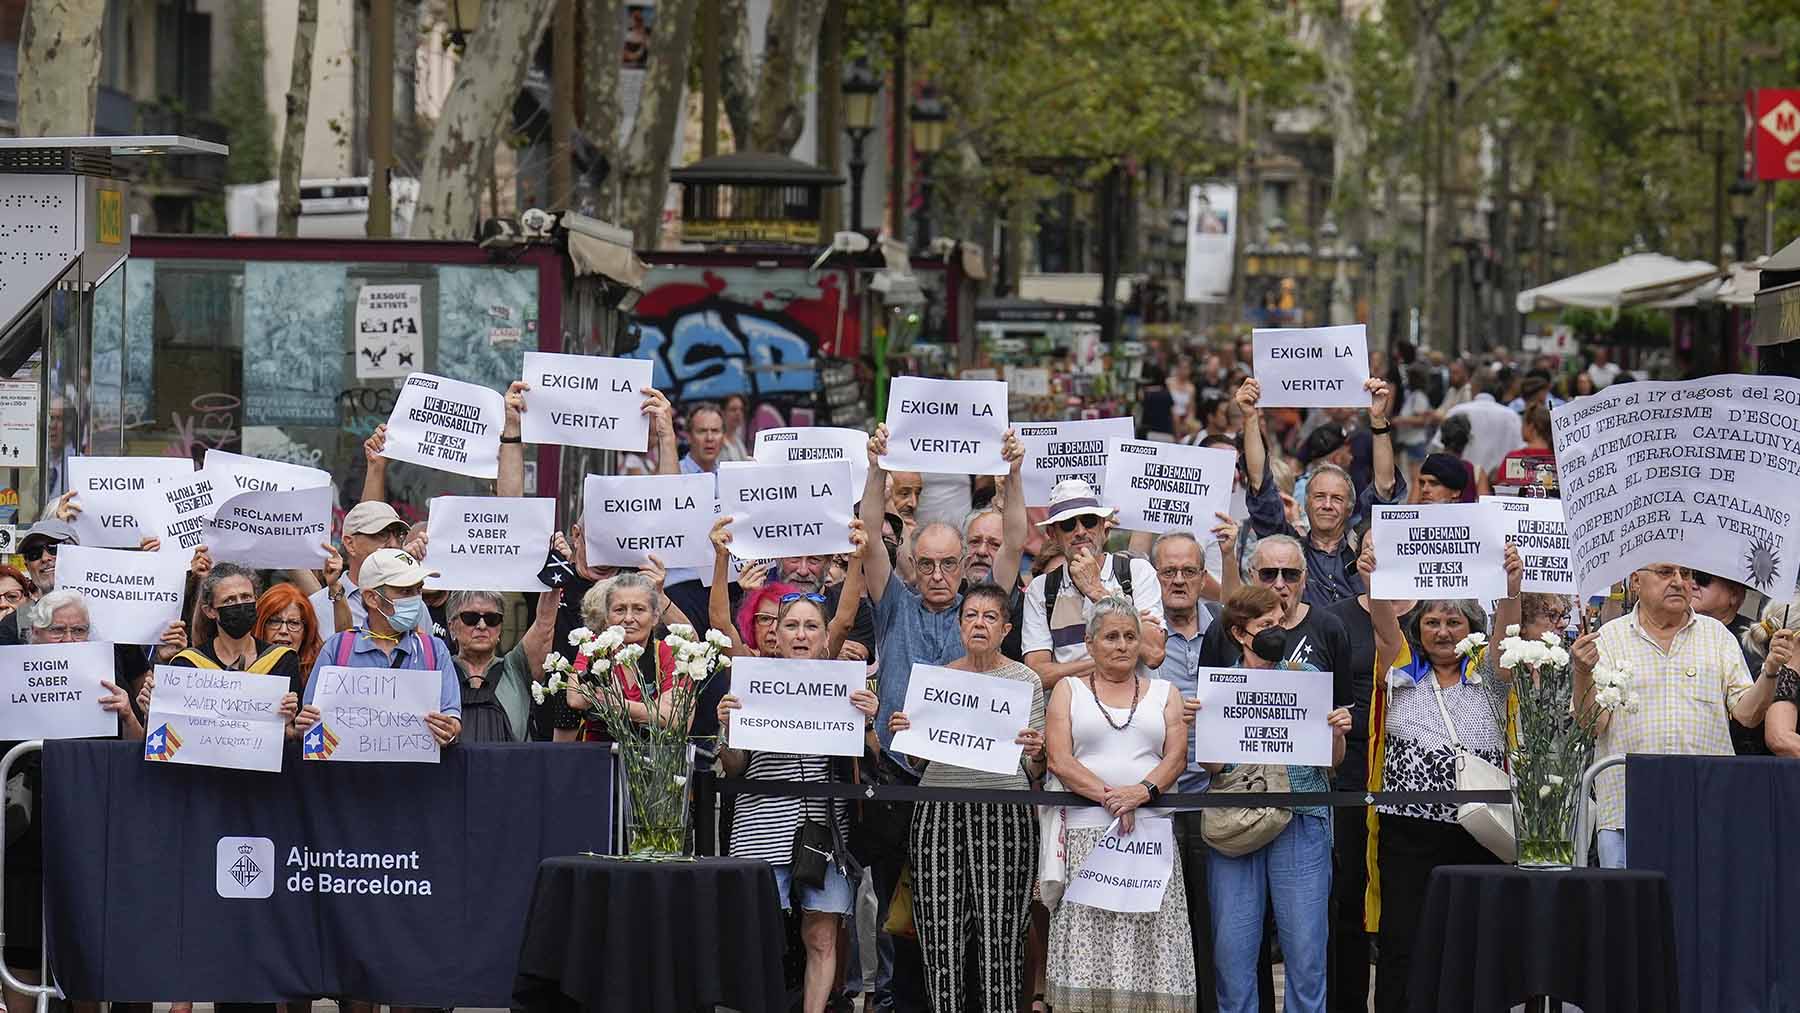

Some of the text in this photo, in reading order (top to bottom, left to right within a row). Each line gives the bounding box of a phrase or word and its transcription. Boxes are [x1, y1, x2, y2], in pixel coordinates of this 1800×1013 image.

[1777, 112, 1794, 130] M
[1271, 346, 1352, 359] EXIGIM LA
[542, 374, 632, 392] EXIGIM LA
[1282, 379, 1344, 391] VERITAT
[426, 397, 480, 418] WE DEMAND
[902, 400, 993, 416] EXIGIM LA
[1555, 417, 1570, 431] Va
[1574, 398, 1620, 426] passar
[1625, 393, 1640, 405] el
[1648, 391, 1666, 402] 17
[1672, 387, 1733, 402] d'agost
[1743, 388, 1768, 400] del
[409, 408, 487, 435] RESPONSABILITY
[551, 412, 619, 430] VERITAT
[1596, 407, 1712, 432] TERRORISME
[426, 432, 465, 448] WE ASK
[910, 438, 980, 454] VERITAT
[1049, 441, 1102, 454] WE DEMAND
[418, 443, 467, 463] THE TRUTH
[790, 448, 842, 460] WE DEMAND
[1131, 446, 1156, 455] D'AGOST
[1561, 426, 1800, 478] PER ATEMORIR CATALUNYA
[1146, 464, 1200, 480] WE DEMAND
[1588, 462, 1616, 484] SER
[1627, 446, 1745, 467] TERRORISME
[89, 478, 144, 490] EXIGIM
[1625, 474, 1642, 488] EL
[1646, 466, 1700, 481] DESIG
[1712, 468, 1735, 482] DE
[166, 480, 213, 503] THE TRUTH
[740, 484, 832, 502] EXIGIM LA
[1131, 477, 1210, 496] RESPONSABILITY
[196, 494, 213, 508] WE
[604, 496, 695, 513] EXIGIM LA
[1151, 498, 1188, 512] WE ASK
[234, 507, 303, 522] RECLAMEM
[1694, 492, 1790, 527] CATALANS?
[464, 513, 509, 524] EXIGIM
[1143, 510, 1193, 526] THE TRUTH
[210, 518, 325, 536] RESPONSABILITATS
[468, 529, 507, 539] SABER
[753, 523, 824, 538] VERITAT
[1411, 527, 1467, 540] WE DEMAND
[1520, 521, 1535, 533] WE
[1620, 510, 1670, 537] SABER
[1680, 511, 1706, 525] LA
[1717, 515, 1784, 550] VERITAT
[451, 544, 520, 556] LA VERITAT
[617, 535, 685, 550] VERITAT
[1397, 542, 1480, 556] RESPONSABILITY
[1620, 528, 1685, 558] PLEGAT!
[1421, 563, 1461, 573] WE ASK
[1528, 557, 1566, 568] WE ASK
[86, 572, 155, 586] RECLAMEM
[1414, 576, 1468, 587] THE TRUTH
[1541, 570, 1572, 582] TRUTH
[23, 660, 68, 672] EXIGIM
[28, 676, 68, 687] SABER
[320, 672, 397, 699] EXIGIM
[750, 680, 848, 698] RECLAMEM
[12, 691, 82, 703] LA VERITAT
[924, 688, 1010, 715] EXIGIM LA
[1238, 693, 1295, 705] WE DEMAND
[1224, 707, 1308, 720] RESPONSABILITY
[740, 717, 854, 732] RESPONSABILITATS
[928, 727, 995, 751] VERITAT
[1247, 728, 1286, 738] WE ASK
[1240, 740, 1293, 752] THE TRUTH
[286, 846, 419, 871] Ajuntament
[287, 872, 431, 895] de Barcelona
